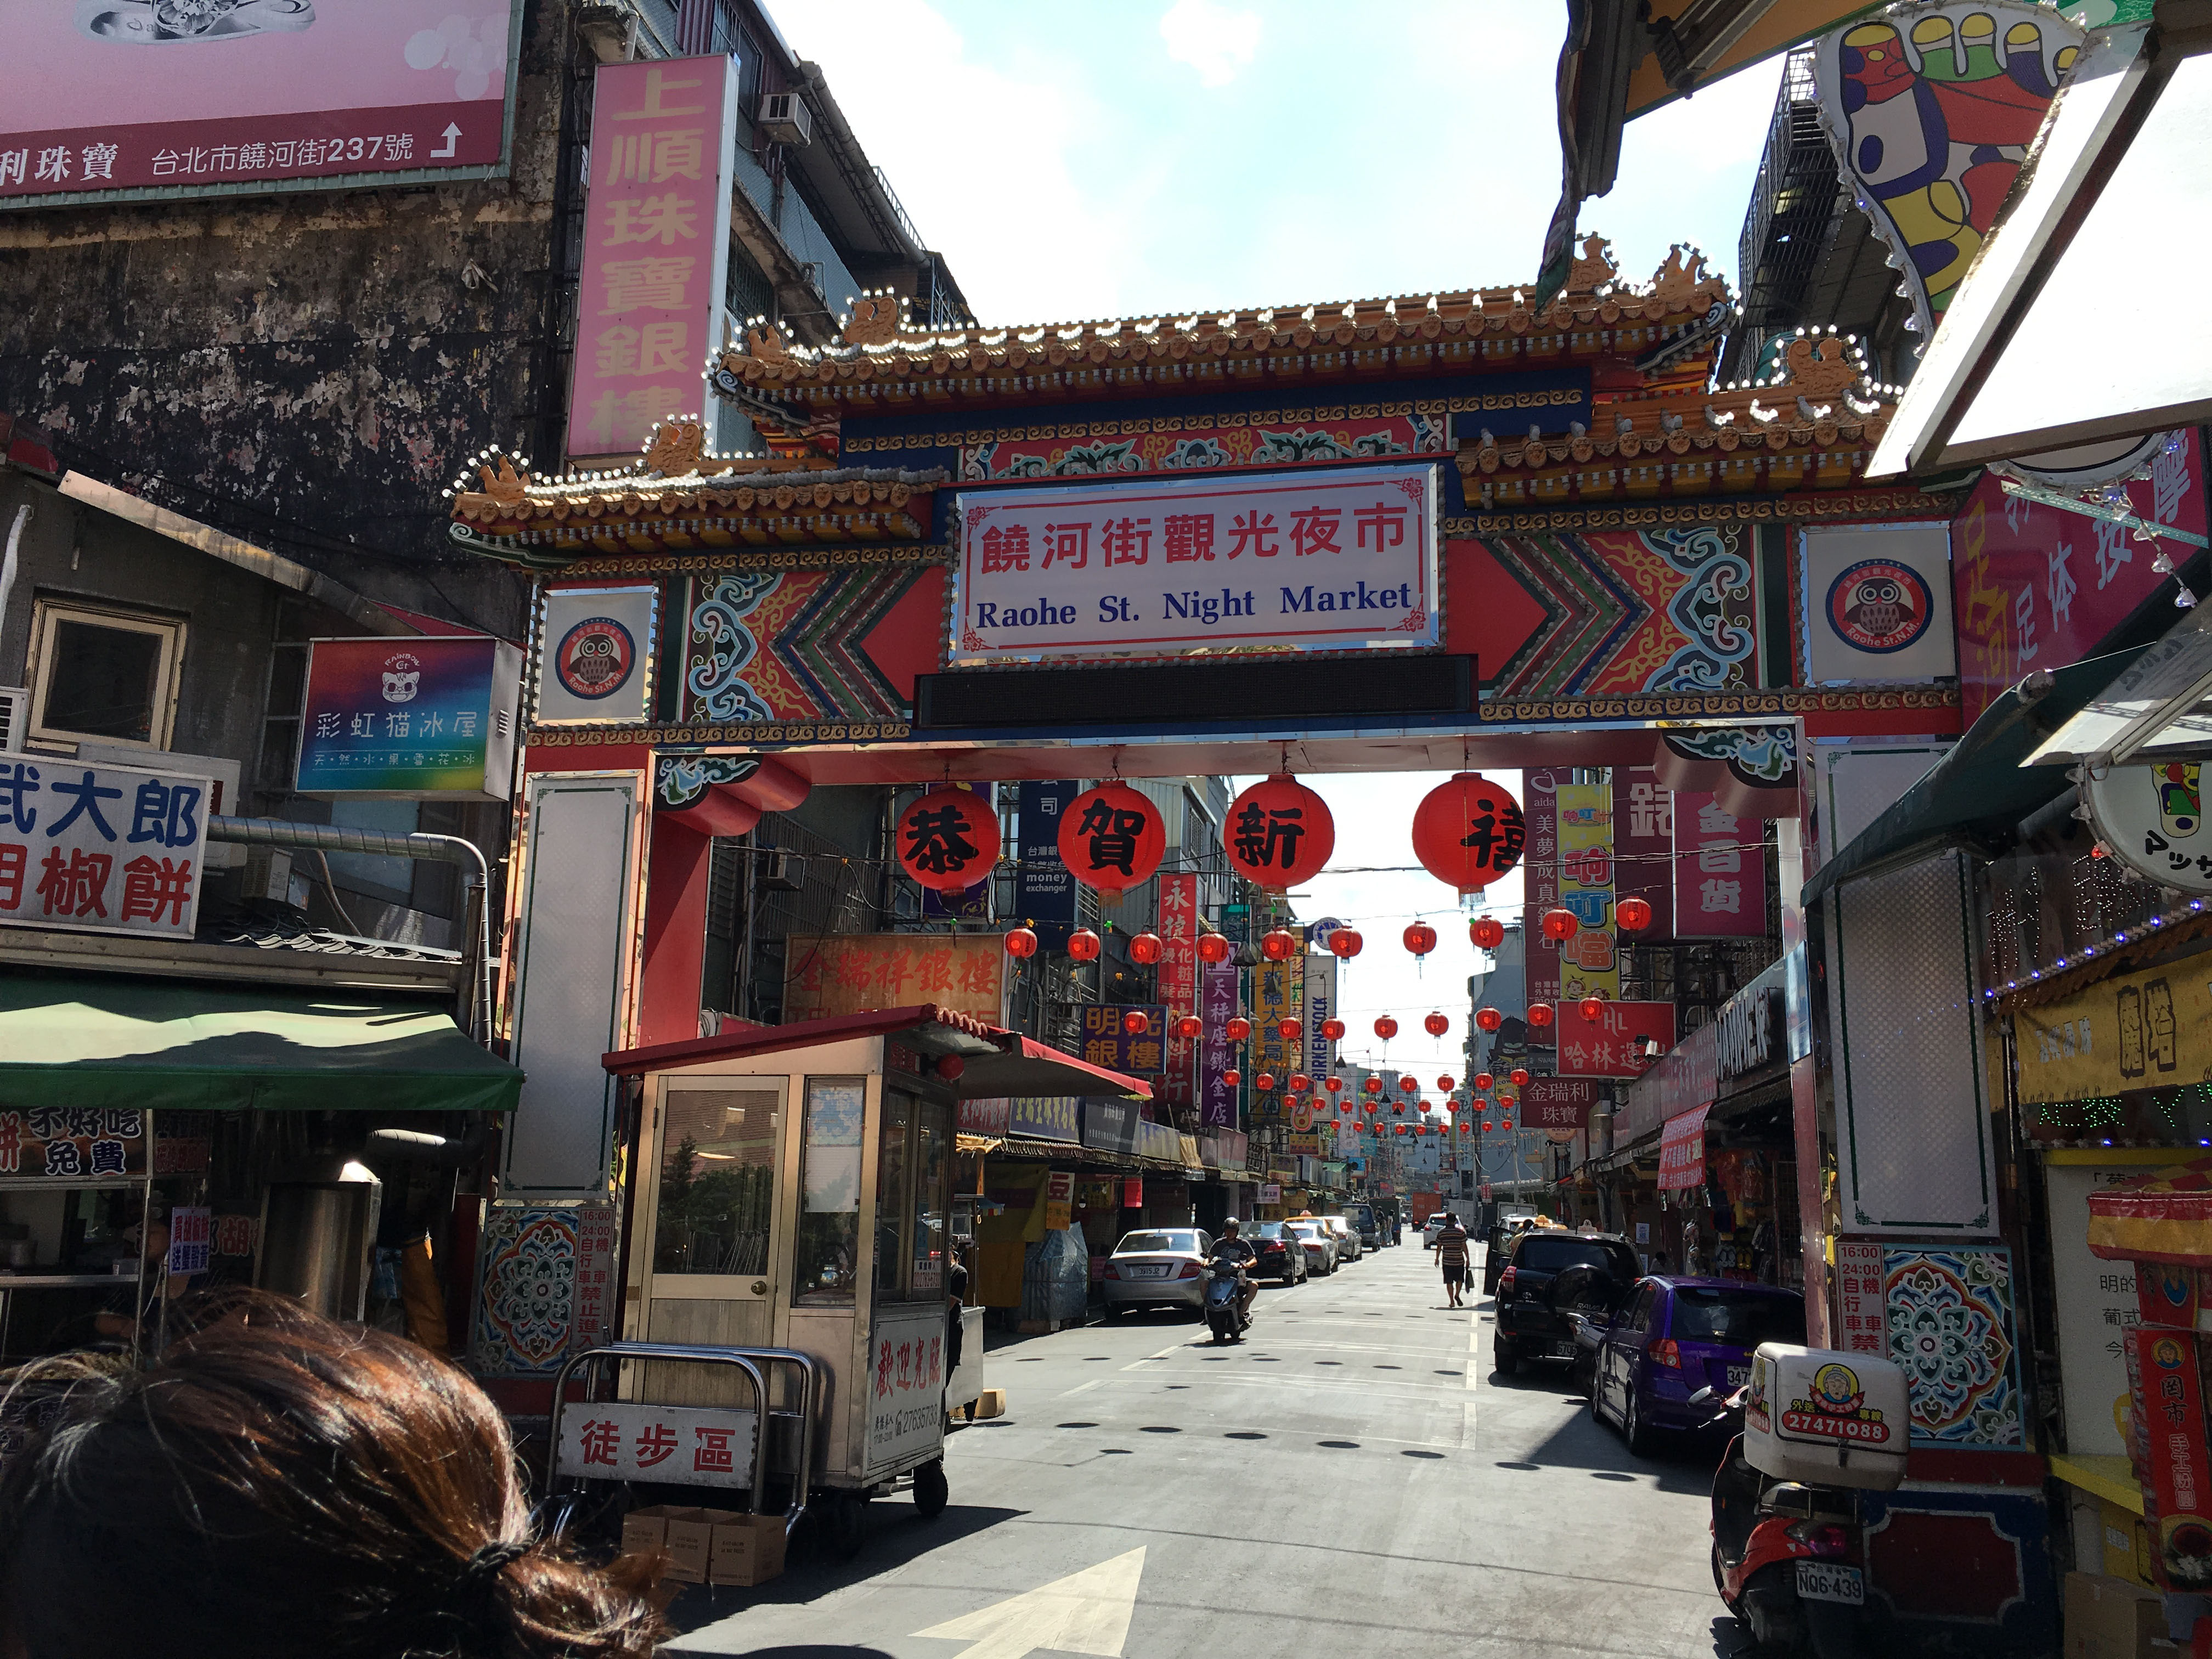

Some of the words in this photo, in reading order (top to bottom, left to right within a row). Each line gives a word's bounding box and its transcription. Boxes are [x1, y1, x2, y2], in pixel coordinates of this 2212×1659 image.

[0, 144, 119, 184] 利珠寶
[151, 133, 414, 177] 台北市饒河街237號
[586, 69, 706, 444] 上順珠寶銀樓
[981, 502, 1408, 575] 饒河街觀光夜市
[976, 599, 1076, 629] Raohe
[1099, 595, 1139, 622] St.
[1163, 589, 1255, 625] Night
[1280, 581, 1412, 614] Market
[1847, 627, 1881, 647] Raohe
[568, 676, 593, 693] Raohe
[1534, 797, 1555, 808] aida
[905, 805, 979, 874] 恭
[1078, 798, 1146, 877] 賀
[1234, 802, 1305, 869] 新
[1460, 799, 1526, 872] 禧
[1026, 874, 1068, 884] money
[1026, 883, 1068, 894] exchanger
[793, 947, 998, 996] 金瑞祥銀樓
[1312, 996, 1327, 1082] BIRKENSTOCK
[1085, 1041, 1161, 1069] 銀樓
[1527, 1081, 1589, 1103] 金瑞利
[29, 1106, 142, 1139] 不好吃
[1542, 1105, 1577, 1124] 珠寶
[45, 1139, 127, 1176] 免費
[582, 1211, 611, 1221] 16:00
[581, 1226, 611, 1236] 24:00
[1841, 1246, 1879, 1259] 16:00
[1842, 1263, 1881, 1276] 24:00
[577, 1286, 601, 1347] 禁止進入
[2102, 1308, 2141, 1326] 葡式
[2106, 1341, 2123, 1359] 今
[876, 1335, 941, 1402] 歡迎光臨
[1728, 1370, 1751, 1384] 347
[902, 1403, 938, 1434] 27635733
[1791, 1398, 1816, 1413] 外送
[1789, 1414, 1883, 1440] 27471088
[580, 1419, 736, 1473] 徒步區
